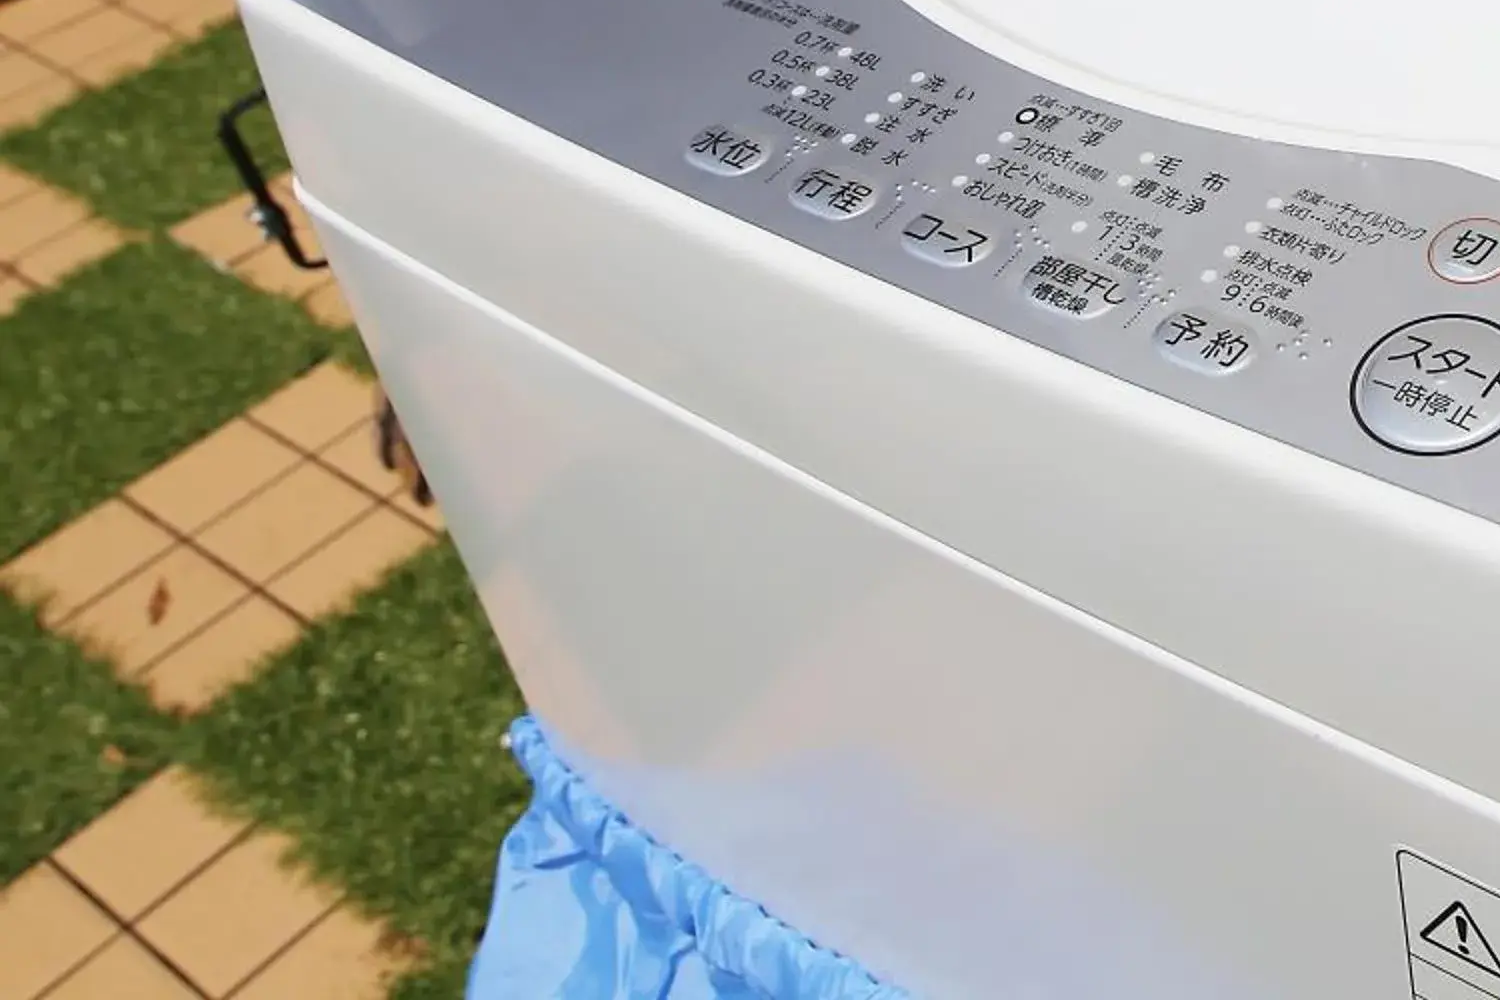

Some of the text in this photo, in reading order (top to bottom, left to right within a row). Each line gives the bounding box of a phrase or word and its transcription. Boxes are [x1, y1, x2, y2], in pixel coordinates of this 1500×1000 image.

[824, 69, 859, 91] 38L
[850, 51, 881, 71] 48L
[801, 89, 836, 111] 23L
[901, 97, 958, 125] すすぎ
[690, 129, 762, 169] 水位
[797, 168, 873, 213] 行程
[903, 213, 989, 263] コース
[1451, 229, 1499, 265] 切
[1029, 255, 1126, 305] 部屋干し
[1164, 312, 1249, 367] 予約
[1371, 378, 1480, 433] 一時停止
